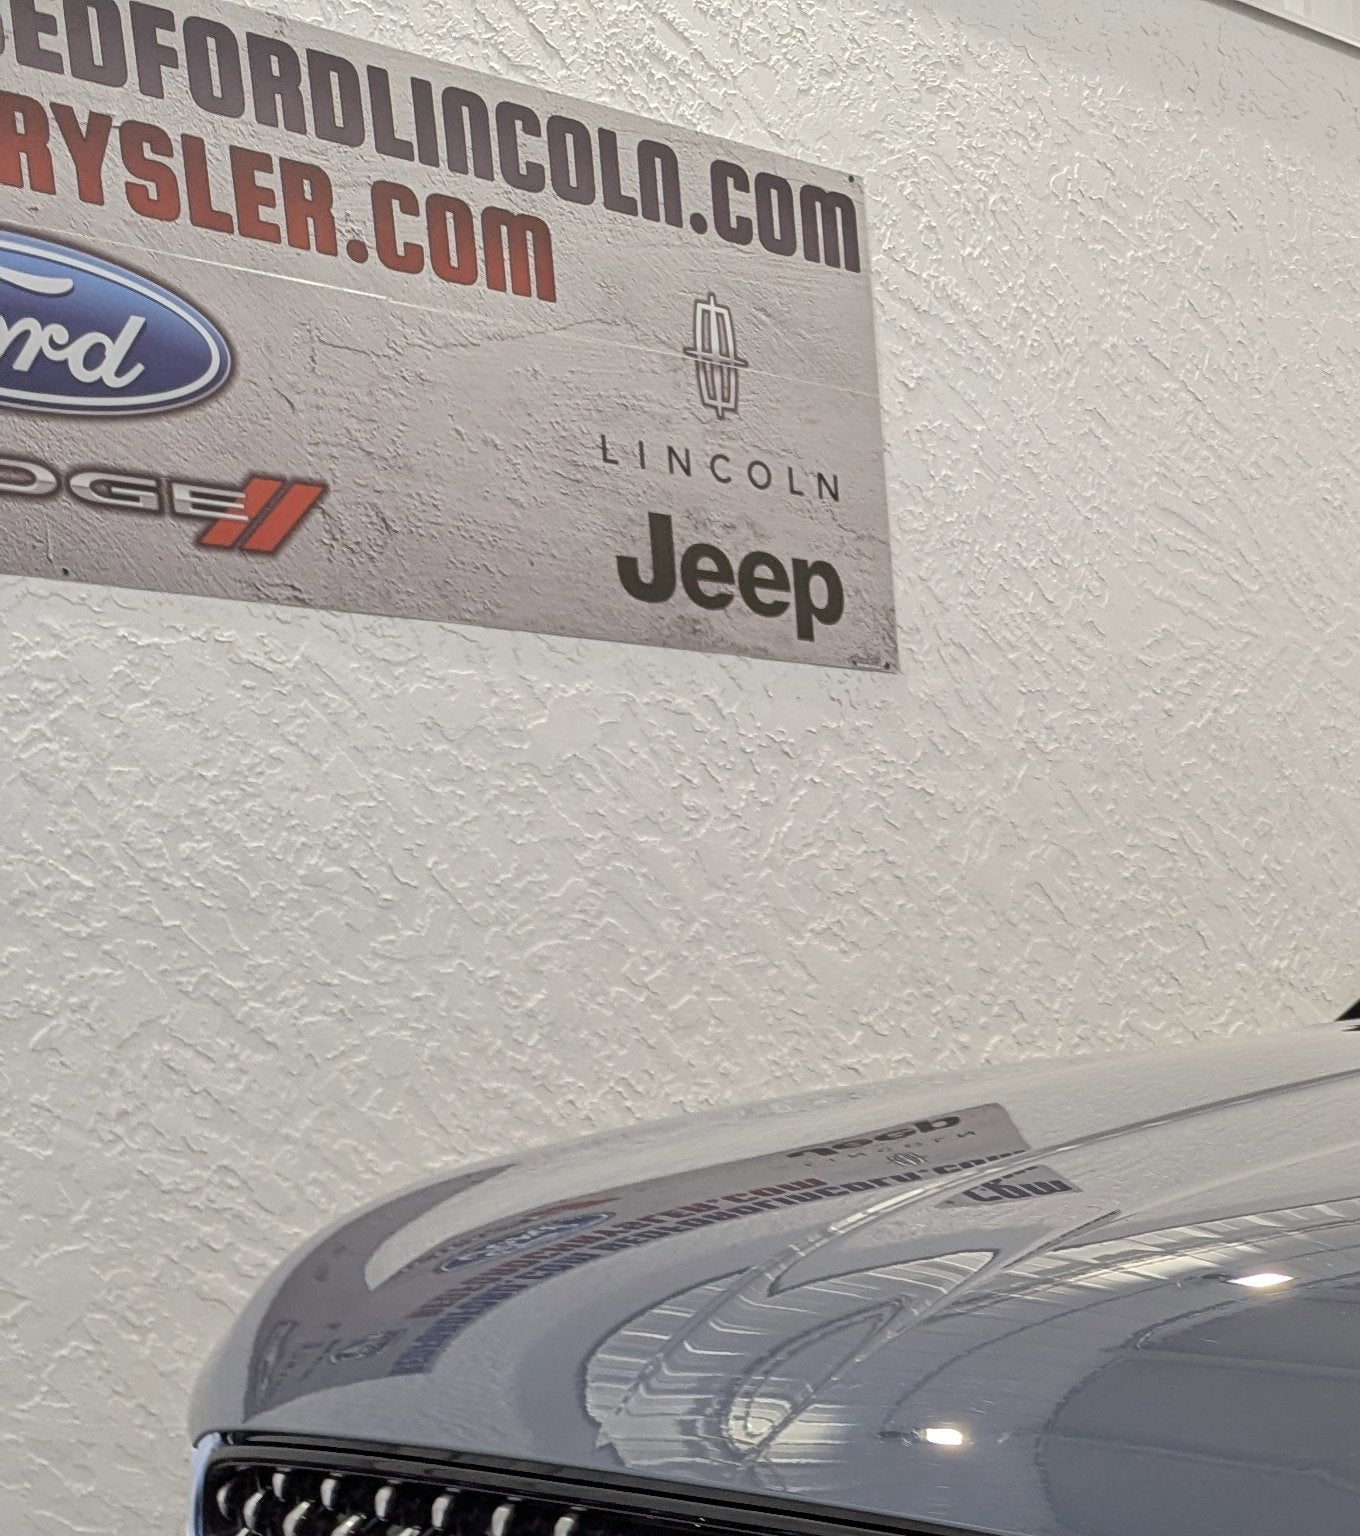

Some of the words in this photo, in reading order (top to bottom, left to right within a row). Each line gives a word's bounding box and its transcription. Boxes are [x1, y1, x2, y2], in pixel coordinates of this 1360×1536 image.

[0, 0, 862, 274] EDFORDLINCOLN.COM
[600, 434, 840, 502] LINCOLN
[616, 511, 845, 642] Jeep
